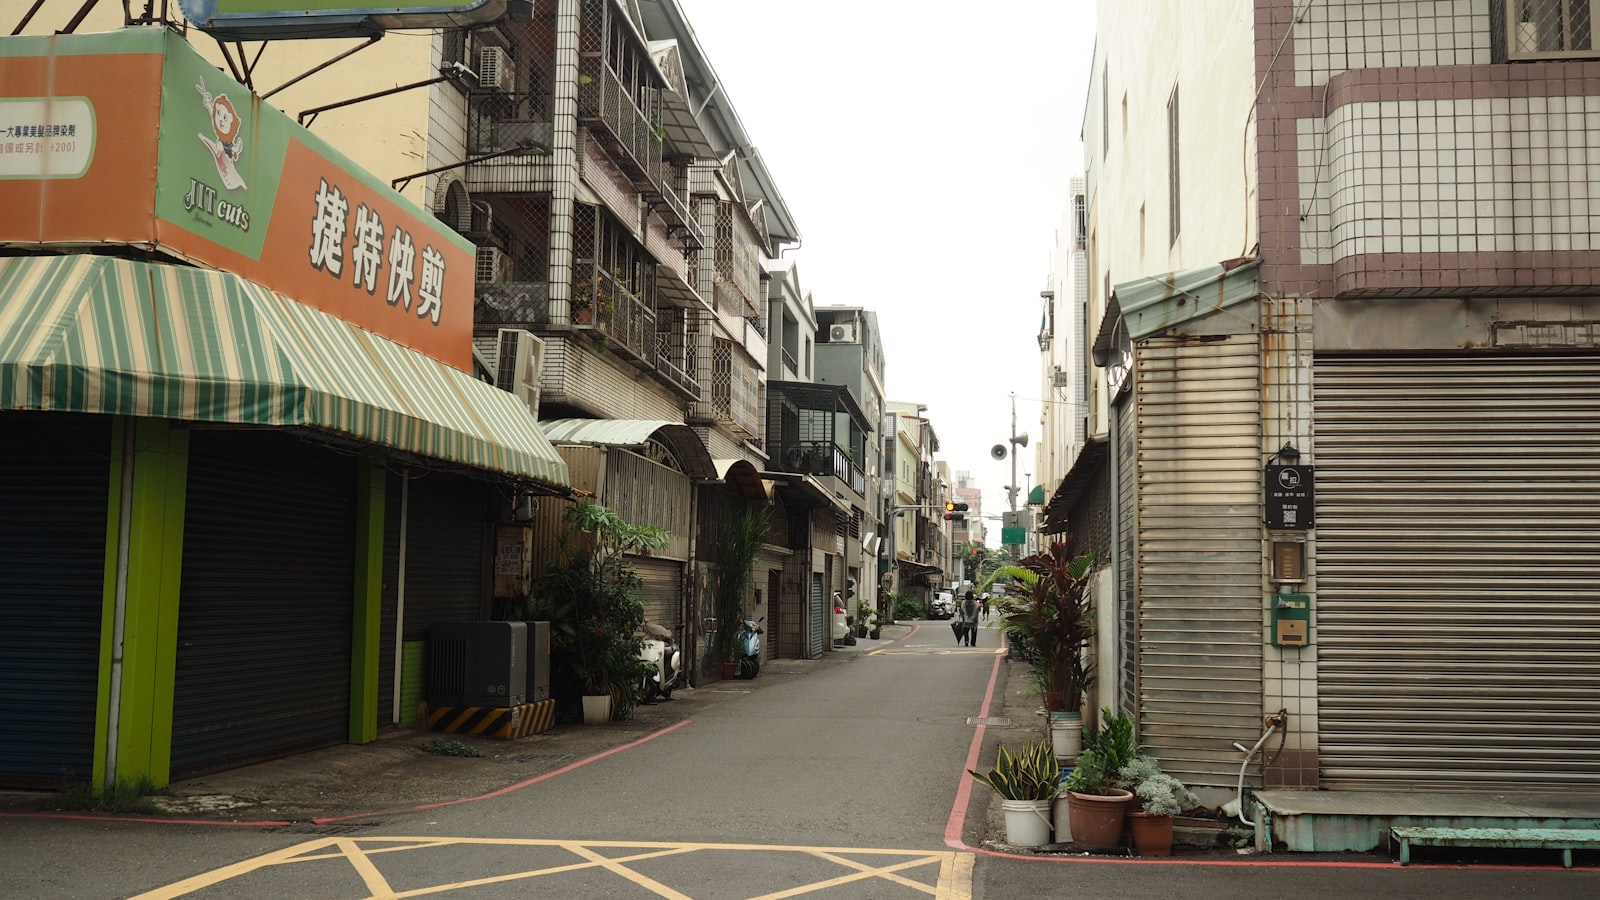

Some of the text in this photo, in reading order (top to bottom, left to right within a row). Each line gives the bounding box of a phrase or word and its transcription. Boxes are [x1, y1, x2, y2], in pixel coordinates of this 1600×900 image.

[184, 178, 217, 214] JIT
[217, 200, 250, 231] cuts
[309, 177, 446, 325] 捷特快剪
